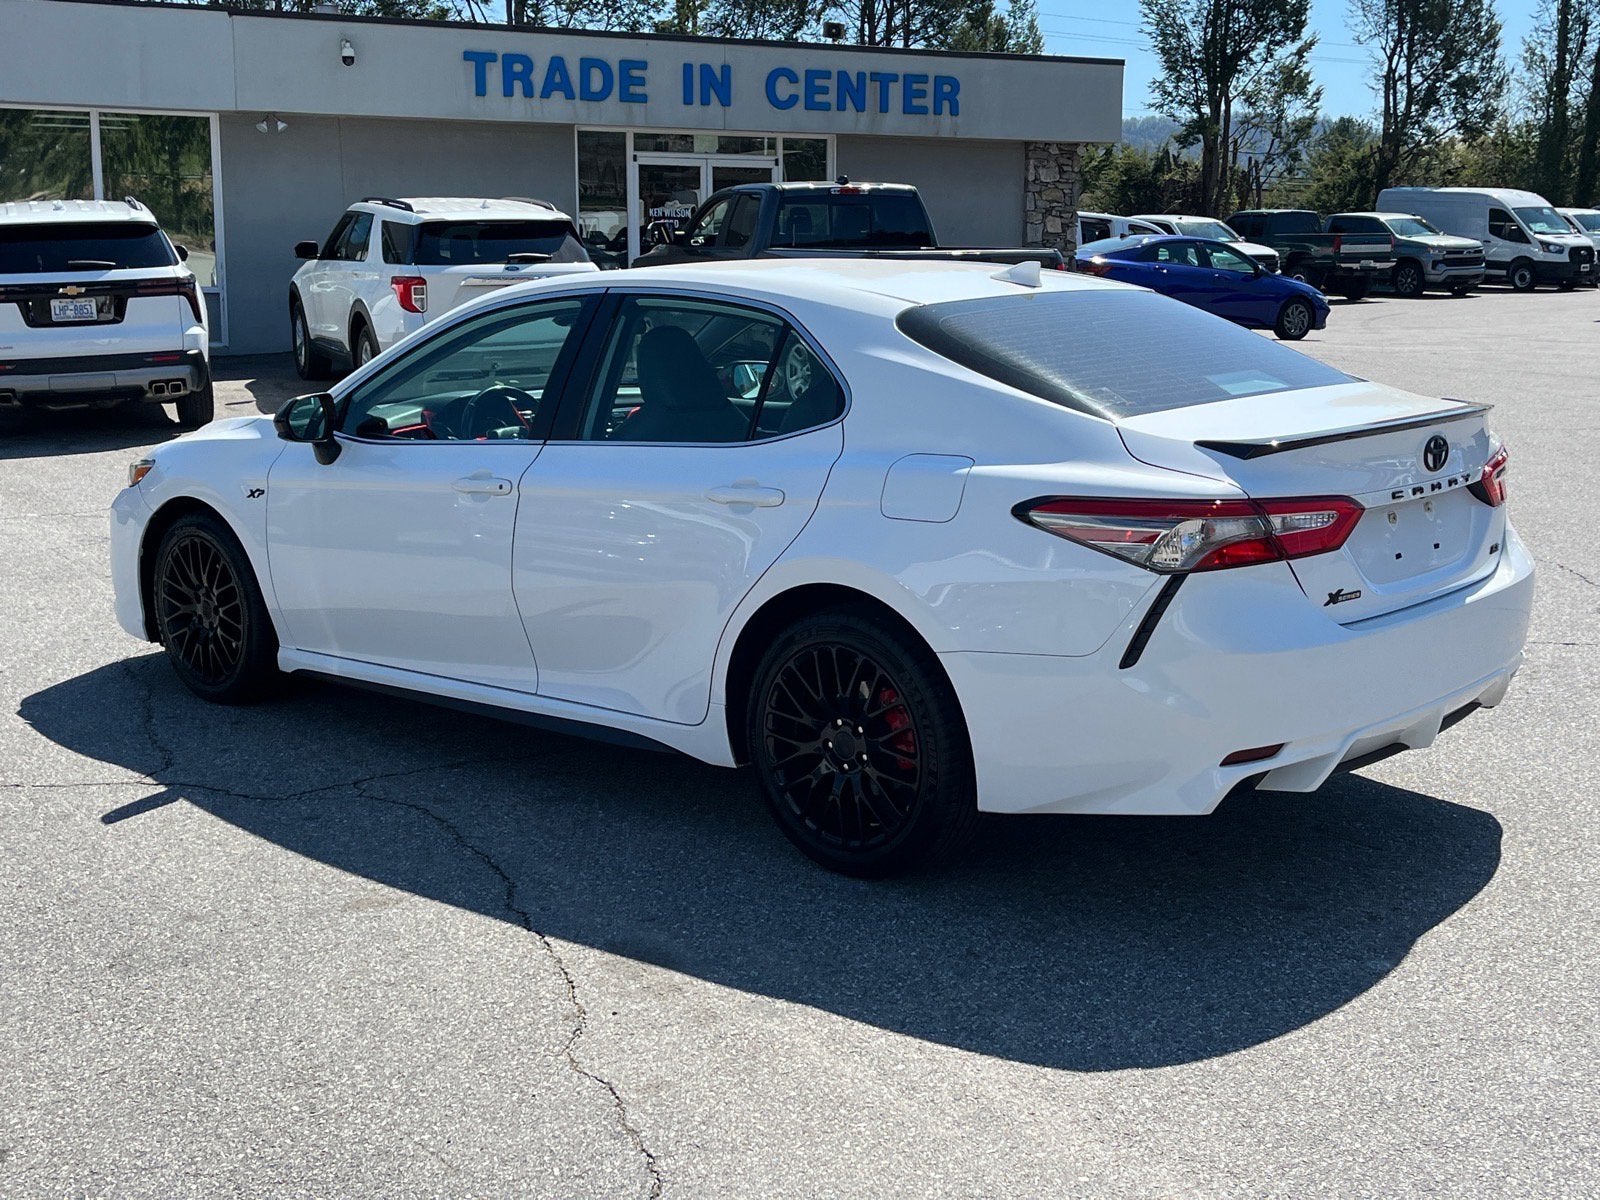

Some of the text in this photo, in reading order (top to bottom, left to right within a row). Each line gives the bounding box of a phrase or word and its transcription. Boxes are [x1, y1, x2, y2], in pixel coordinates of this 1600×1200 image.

[463, 50, 961, 117] TRADE IN CENTER
[649, 207, 691, 219] KEN WILSON
[53, 304, 93, 316] LHP-8851
[1391, 473, 1471, 500] CAMRY
